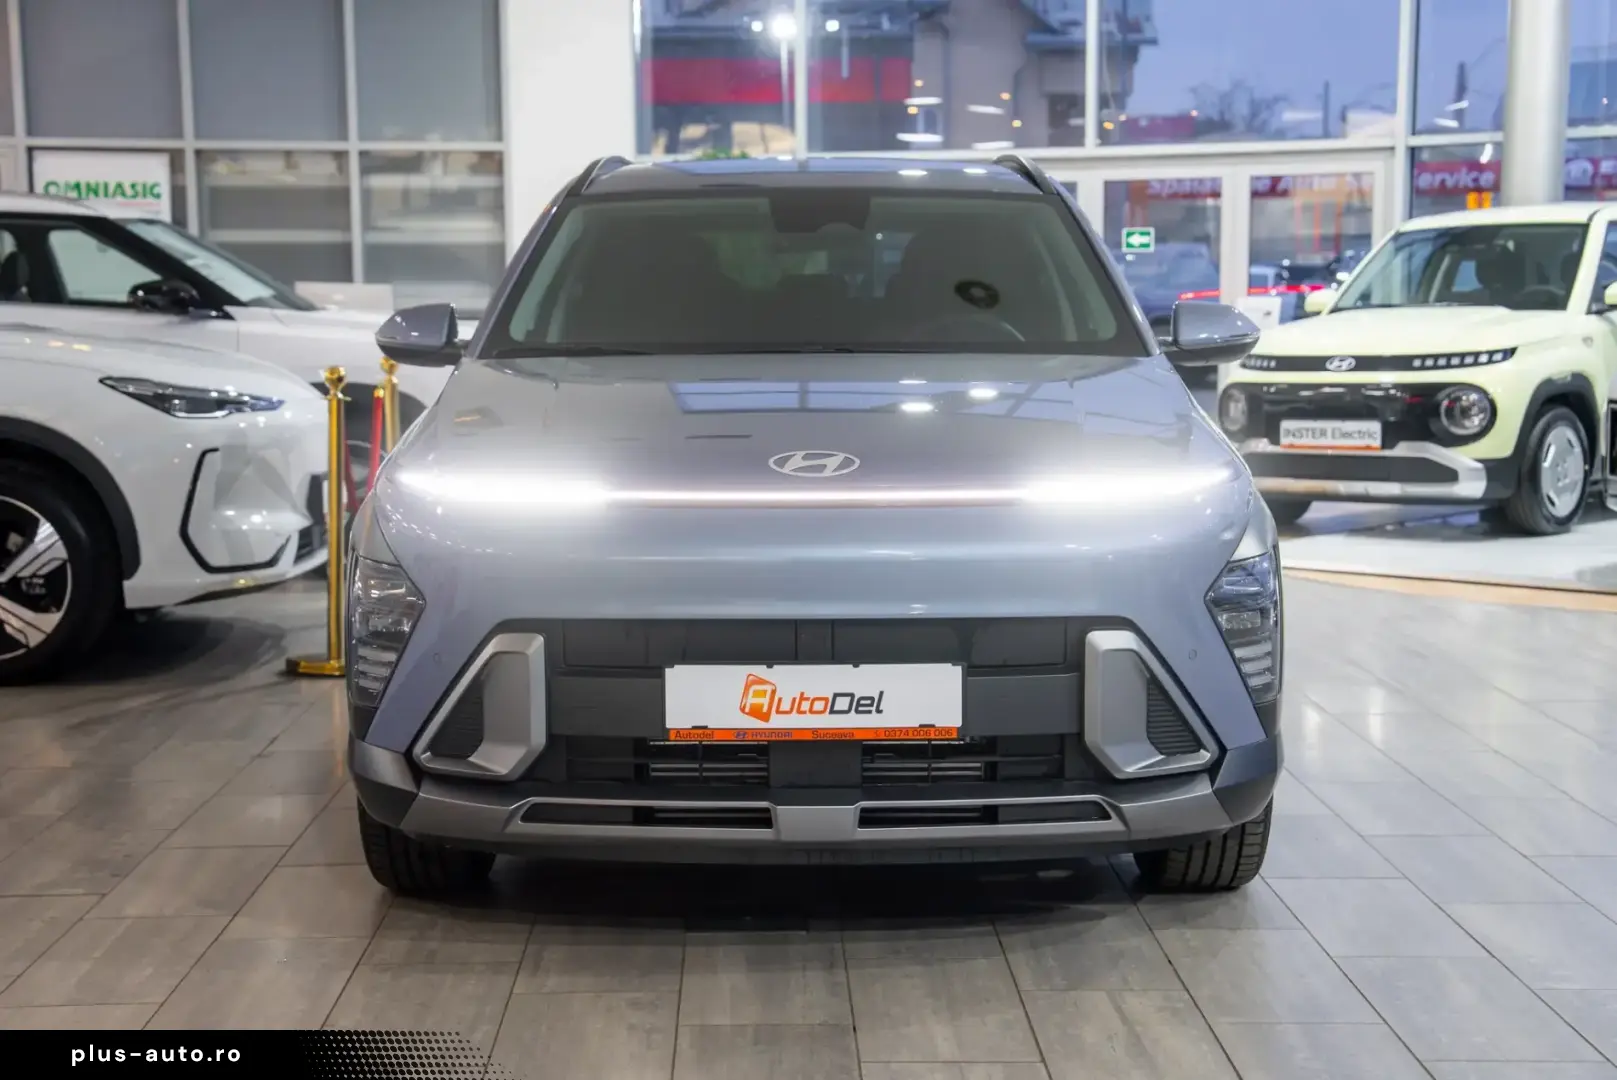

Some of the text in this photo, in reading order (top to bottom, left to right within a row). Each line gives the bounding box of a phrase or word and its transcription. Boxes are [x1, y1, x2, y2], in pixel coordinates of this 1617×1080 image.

[743, 682, 885, 716] AutoDel
[674, 729, 715, 740] Autodel
[811, 729, 855, 740] Suceava
[883, 729, 910, 738] 0374
[911, 729, 932, 738] 006
[933, 728, 953, 737] 006
